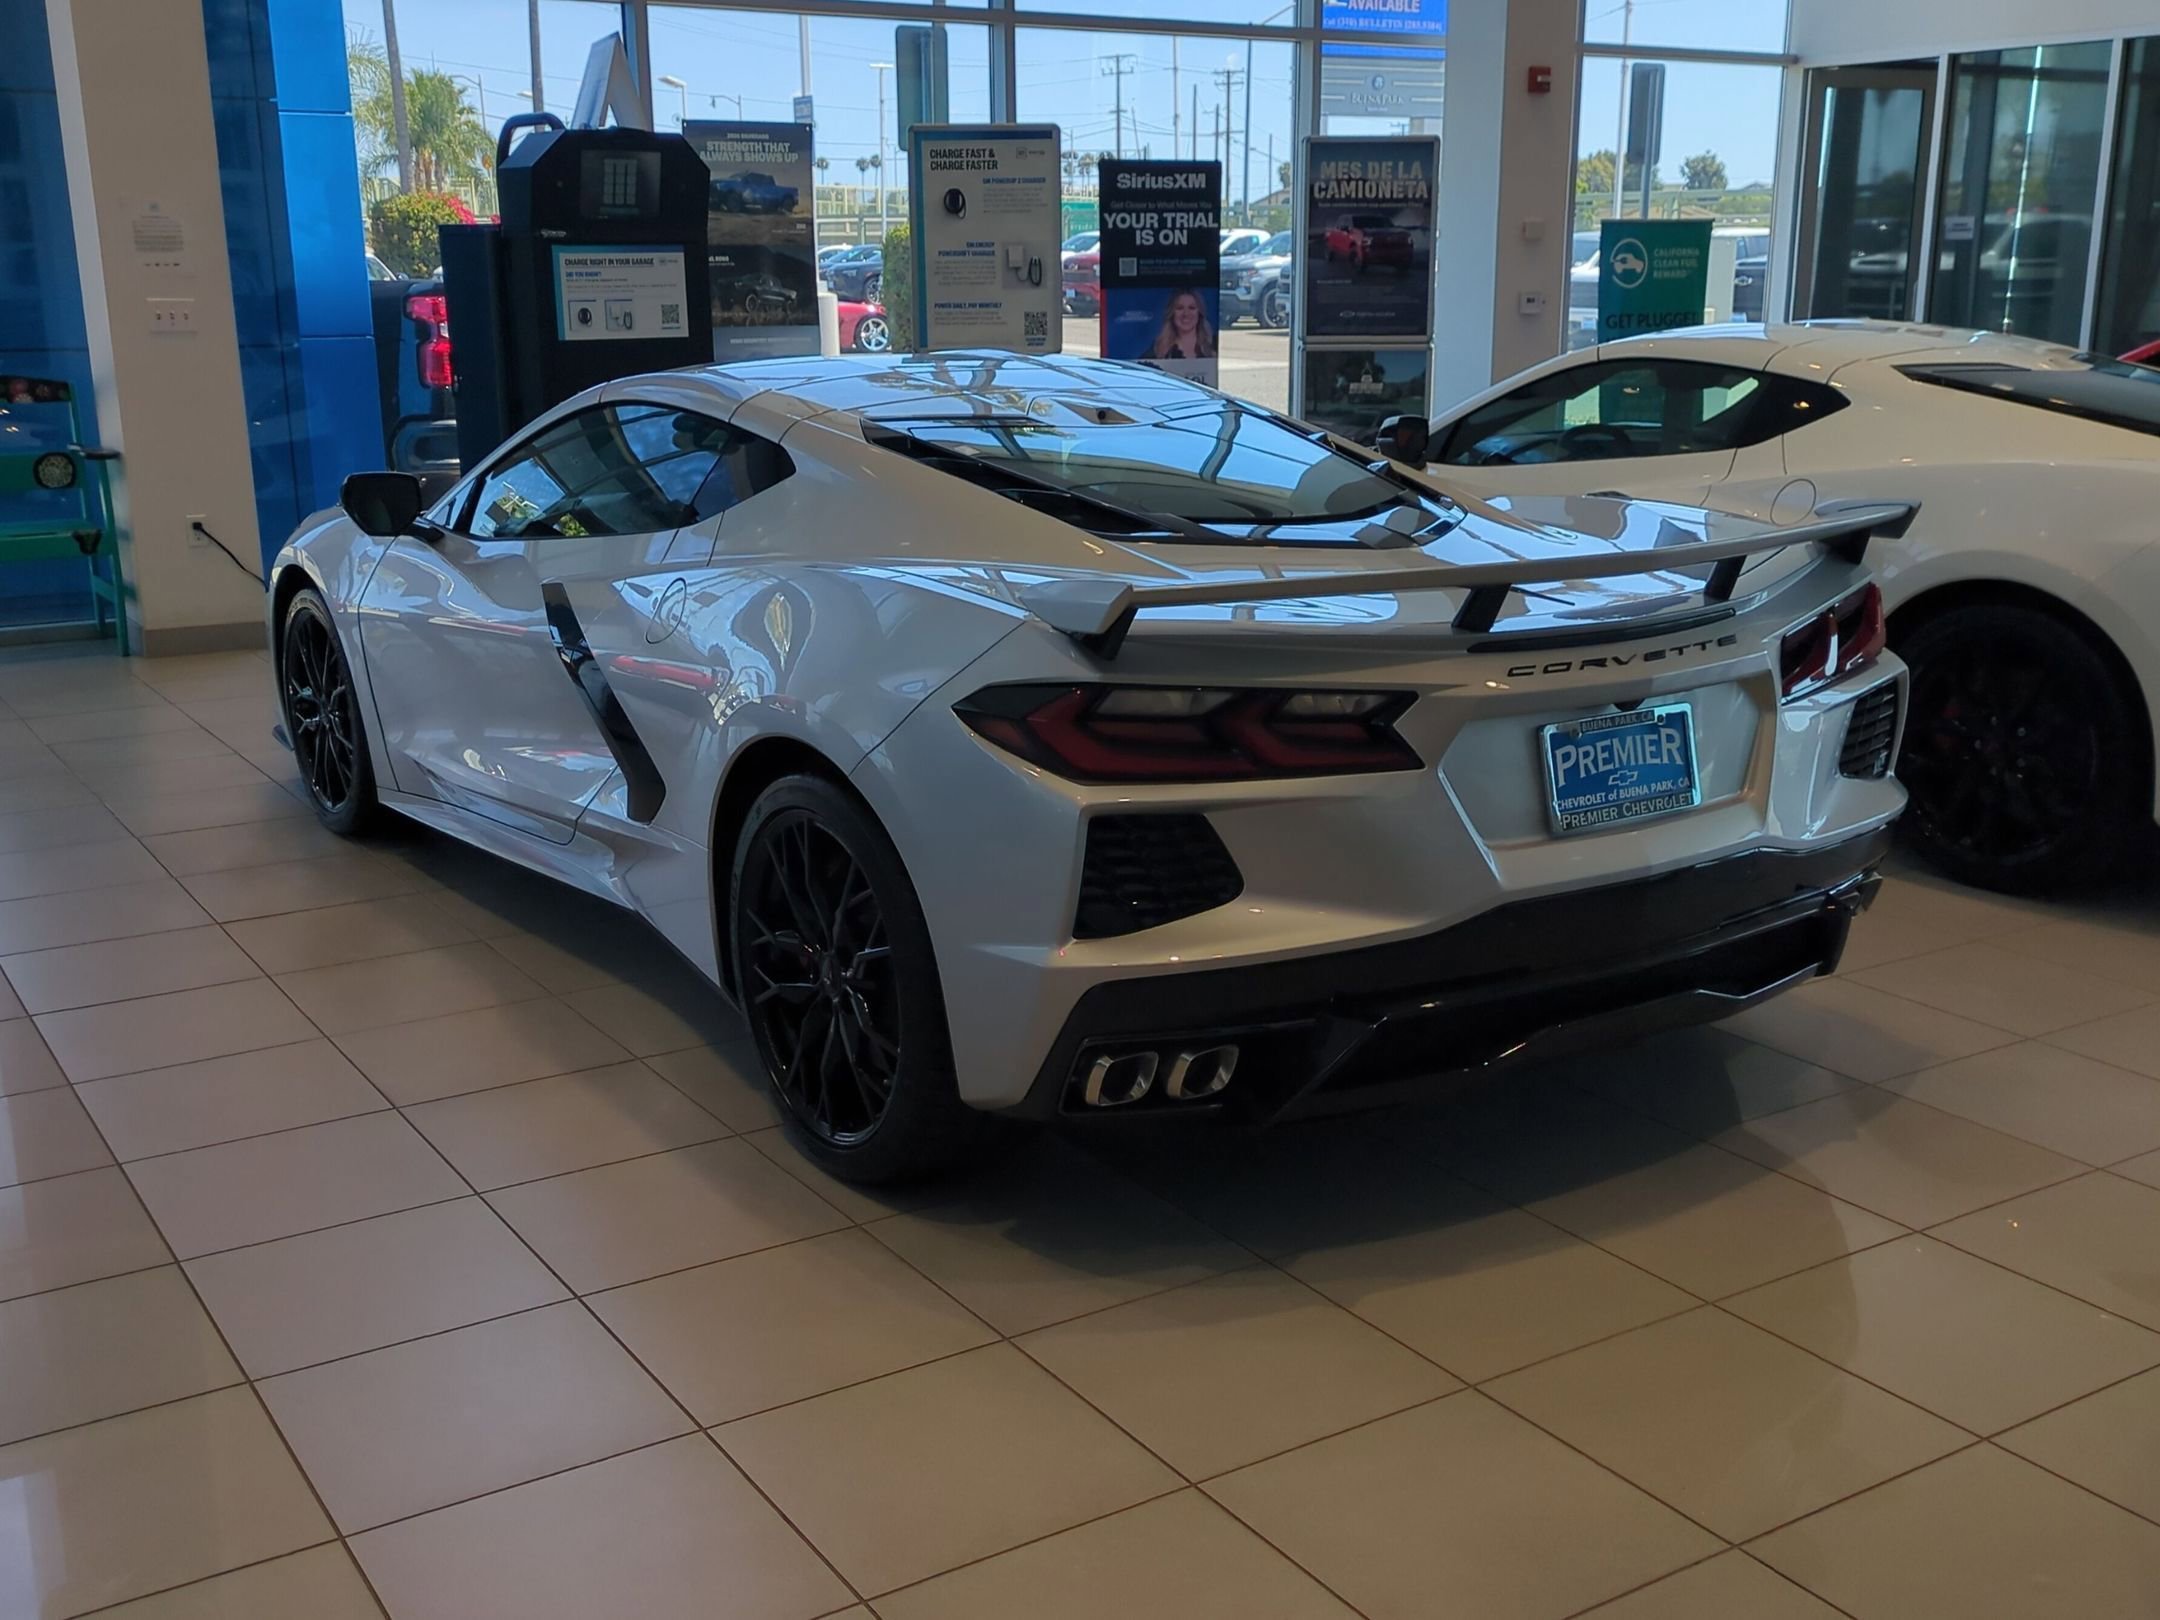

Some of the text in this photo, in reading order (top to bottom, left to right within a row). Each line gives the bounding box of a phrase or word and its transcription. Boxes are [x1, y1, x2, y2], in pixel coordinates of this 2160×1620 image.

[1348, 0, 1420, 13] AVAILABLE
[707, 141, 790, 153] STRENGTH THAT
[930, 148, 995, 159] CHARGE FAST &
[701, 152, 798, 162] ALWAYS SHOWS UP
[930, 160, 998, 171] CHARGE FASTER
[1321, 161, 1423, 179] MES DE LA
[1117, 173, 1206, 189] SiriusXM
[1313, 180, 1428, 198] CAMIONETA
[1104, 212, 1158, 229] YOUR
[1163, 212, 1218, 228] TRIAL
[1136, 229, 1188, 245] IS ON
[1654, 248, 1699, 257] CALIFORNIA
[564, 258, 588, 266] CHARGE
[631, 257, 654, 265] GARAGE
[1681, 259, 1698, 267] FUEL
[1606, 313, 1635, 329] GET
[1507, 634, 1737, 677] CORVETTE
[1582, 717, 1612, 731] BUENA
[1641, 712, 1654, 723] CA
[1555, 727, 1684, 788] PREMIER
[1558, 791, 1605, 810] CHEVROLET
[1608, 789, 1617, 801] of
[1619, 785, 1649, 799] BUENA
[1678, 776, 1690, 787] CA
[1562, 792, 1692, 829] PREMIER CHEVROLET
